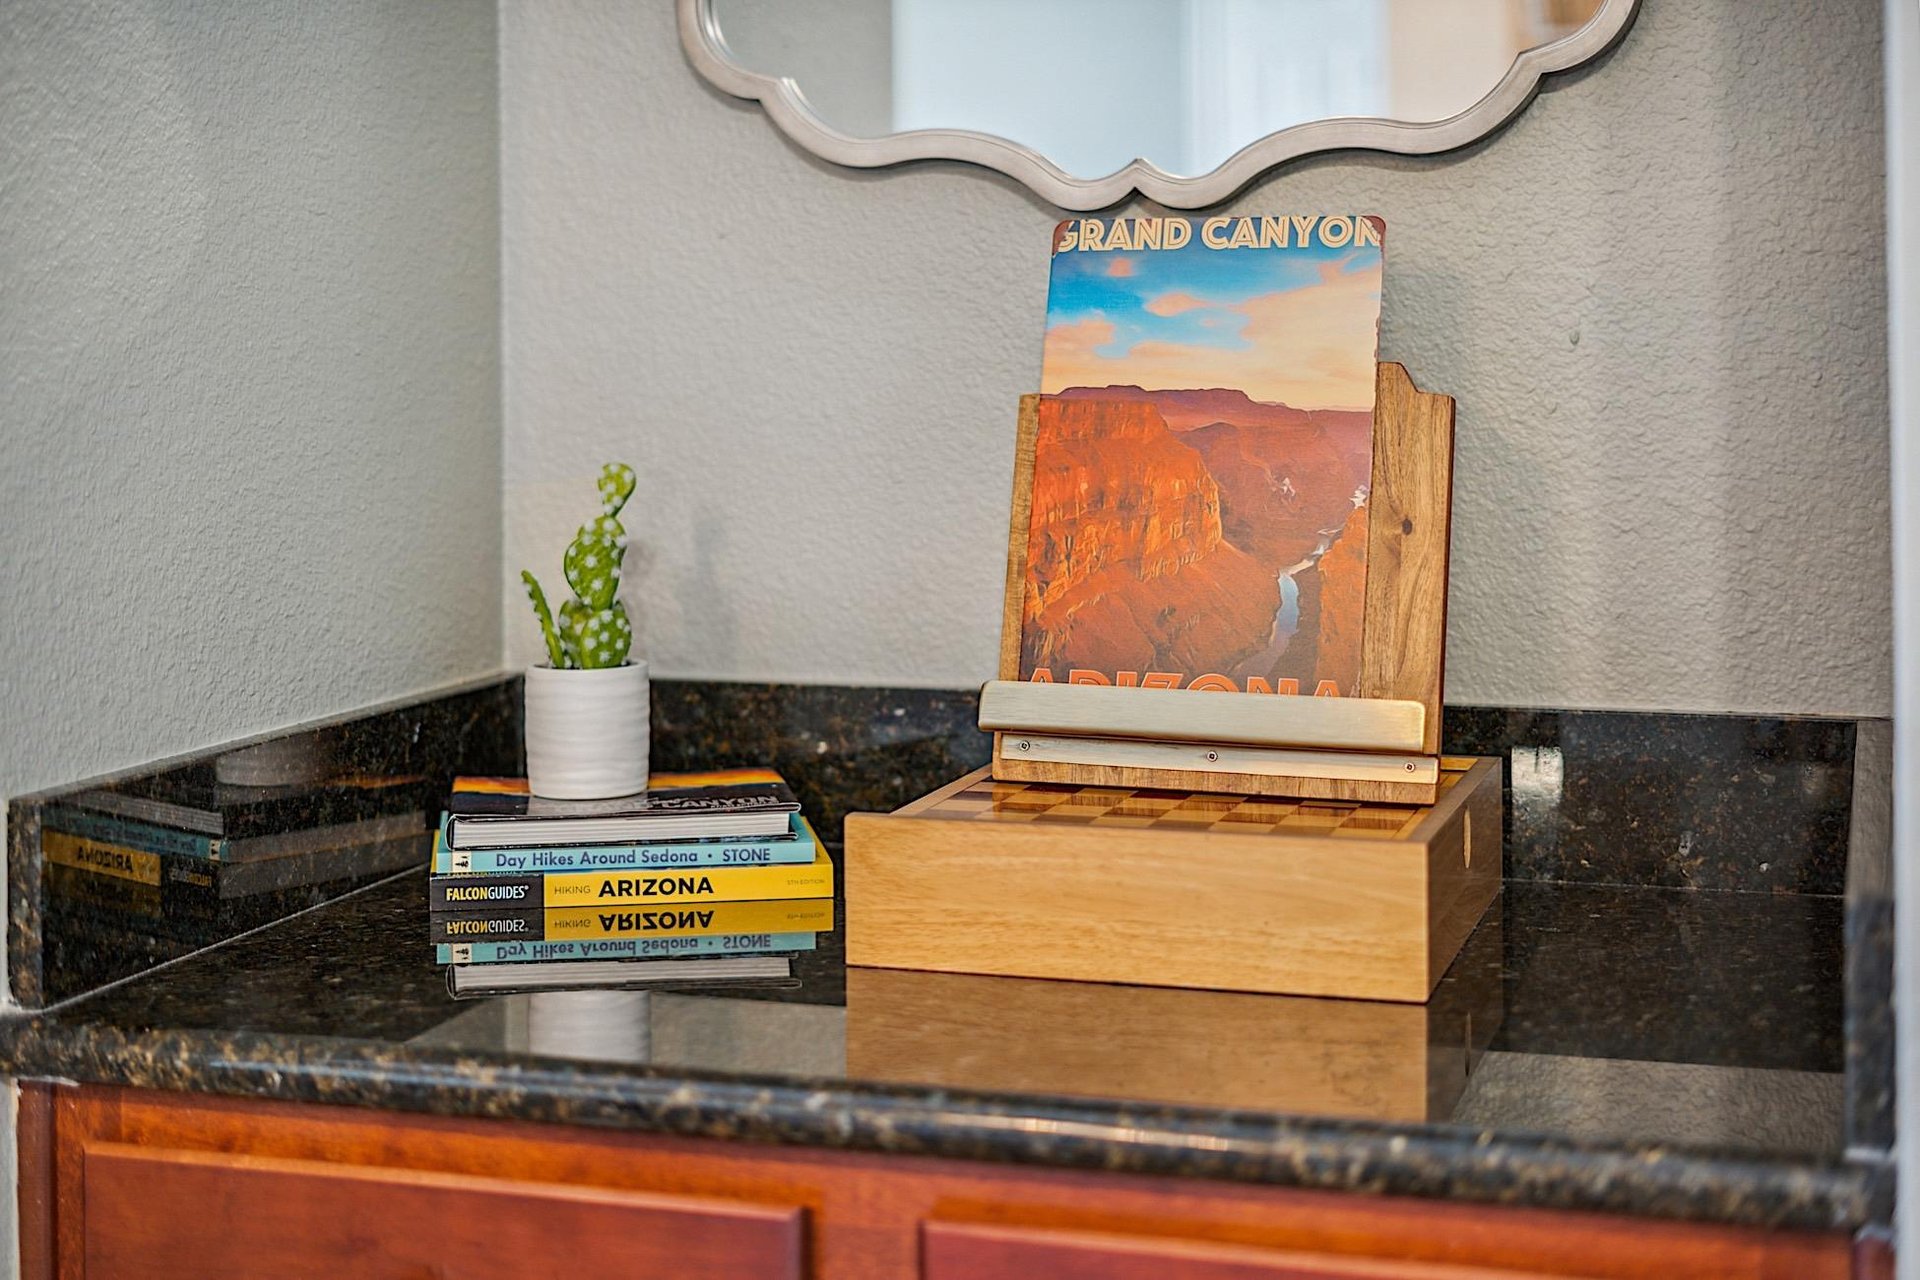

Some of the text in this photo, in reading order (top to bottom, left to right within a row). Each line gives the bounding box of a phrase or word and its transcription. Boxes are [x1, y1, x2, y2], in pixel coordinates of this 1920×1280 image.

[1057, 215, 1381, 252] GRAND CANYON
[496, 847, 771, 869] Day Hikes Around Sedona STONE
[554, 876, 714, 898] HIKING ARIZONA
